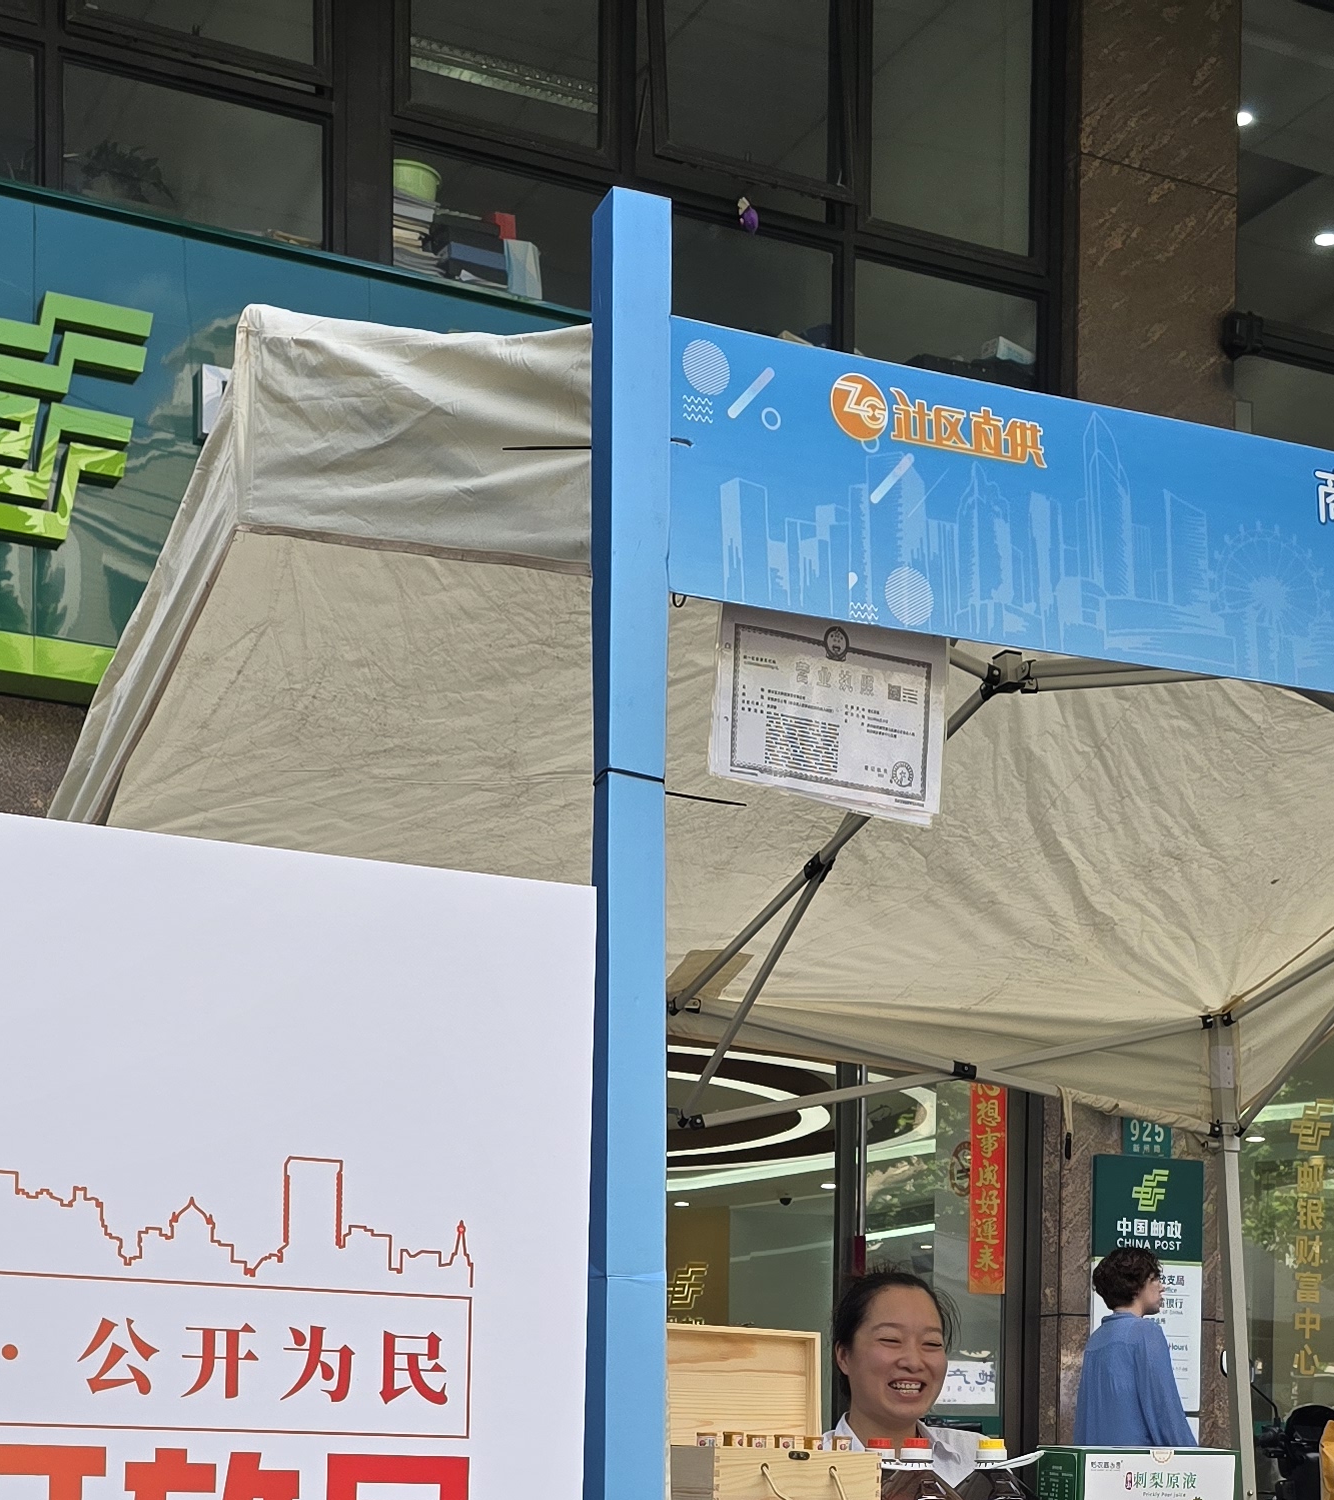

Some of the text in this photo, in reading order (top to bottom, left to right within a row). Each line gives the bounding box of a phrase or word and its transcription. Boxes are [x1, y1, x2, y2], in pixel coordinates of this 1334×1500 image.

[795, 660, 875, 697] 营业执照
[1130, 1119, 1164, 1142] 925
[1116, 1217, 1182, 1239] 中国邮政
[1116, 1237, 1182, 1251] CHINA POST
[1293, 1157, 1325, 1376] 邮银财富中心
[1133, 1471, 1198, 1490] 刺梨原液
